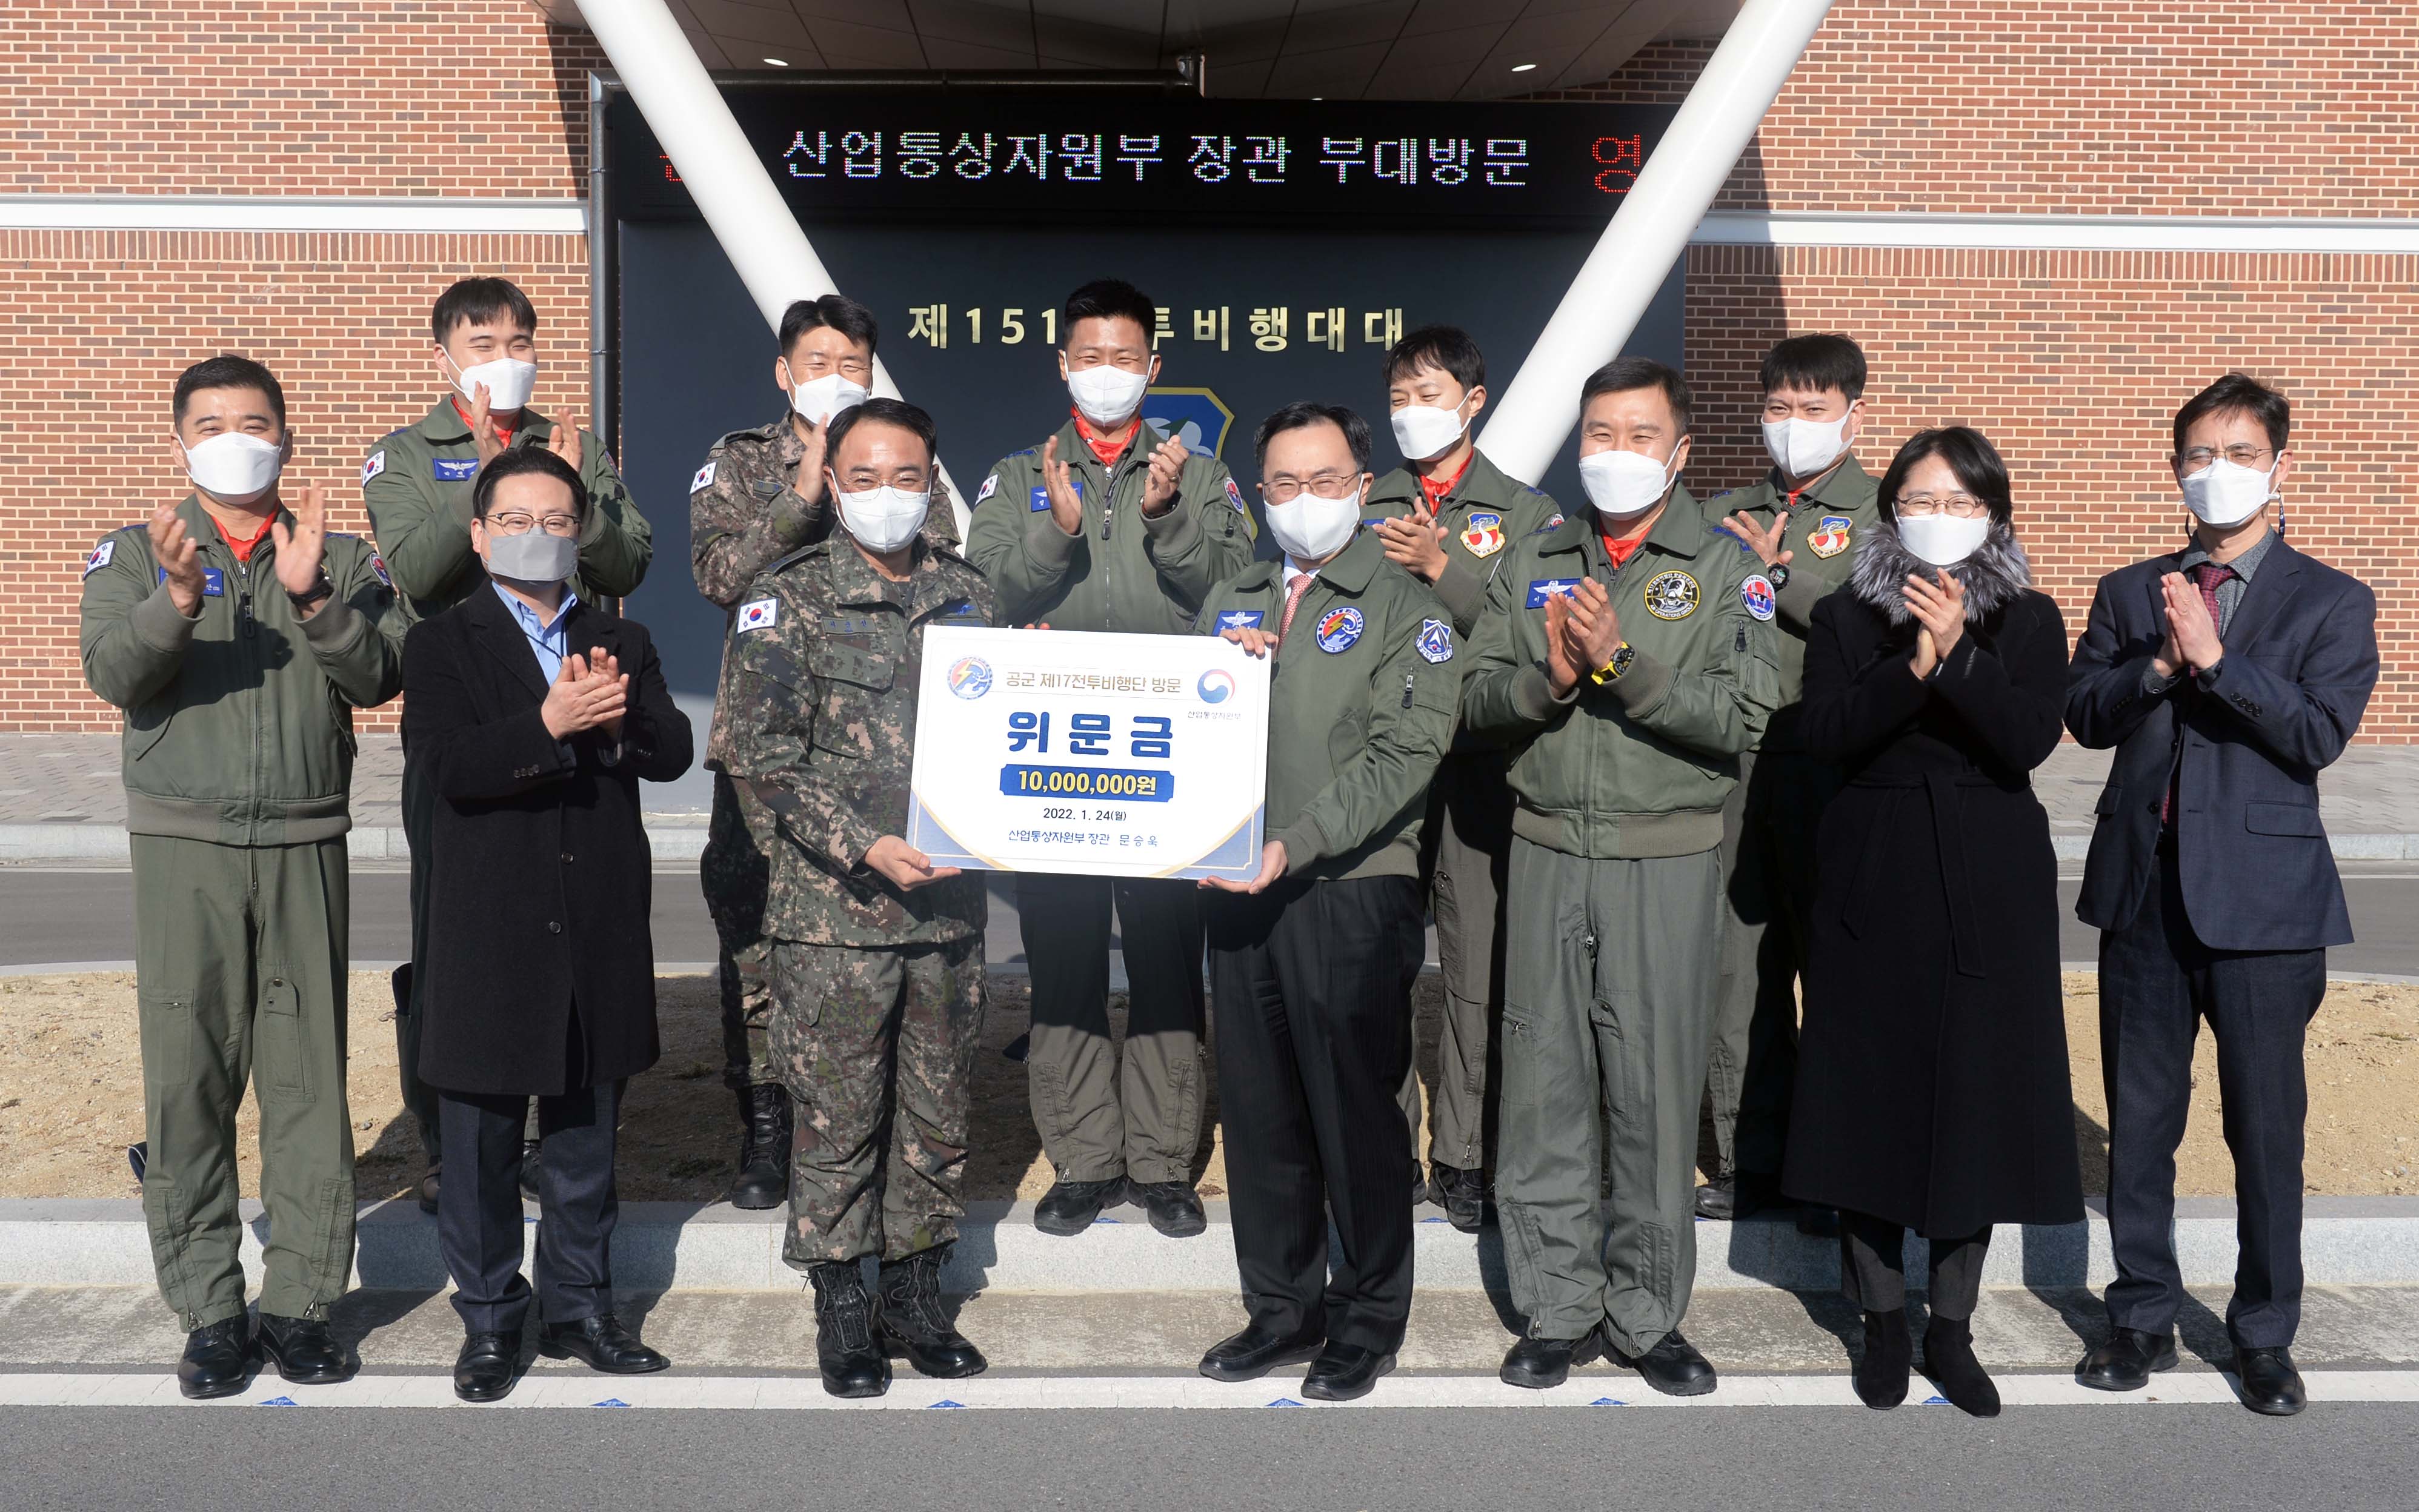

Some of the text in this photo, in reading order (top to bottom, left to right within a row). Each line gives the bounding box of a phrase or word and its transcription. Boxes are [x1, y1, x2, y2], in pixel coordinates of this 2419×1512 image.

[782, 130, 1530, 186] 산업통상자원부 장관 부대방문
[1007, 671, 1181, 693] 공군 제17전투비행단 방문
[1007, 711, 1173, 758] 위문금
[1018, 770, 1157, 796] 10,000,000원
[1043, 807, 1127, 821] 2022. 1. 24(월)
[1008, 829, 1085, 844] 산업통상자원부
[1088, 833, 1110, 846] 장관
